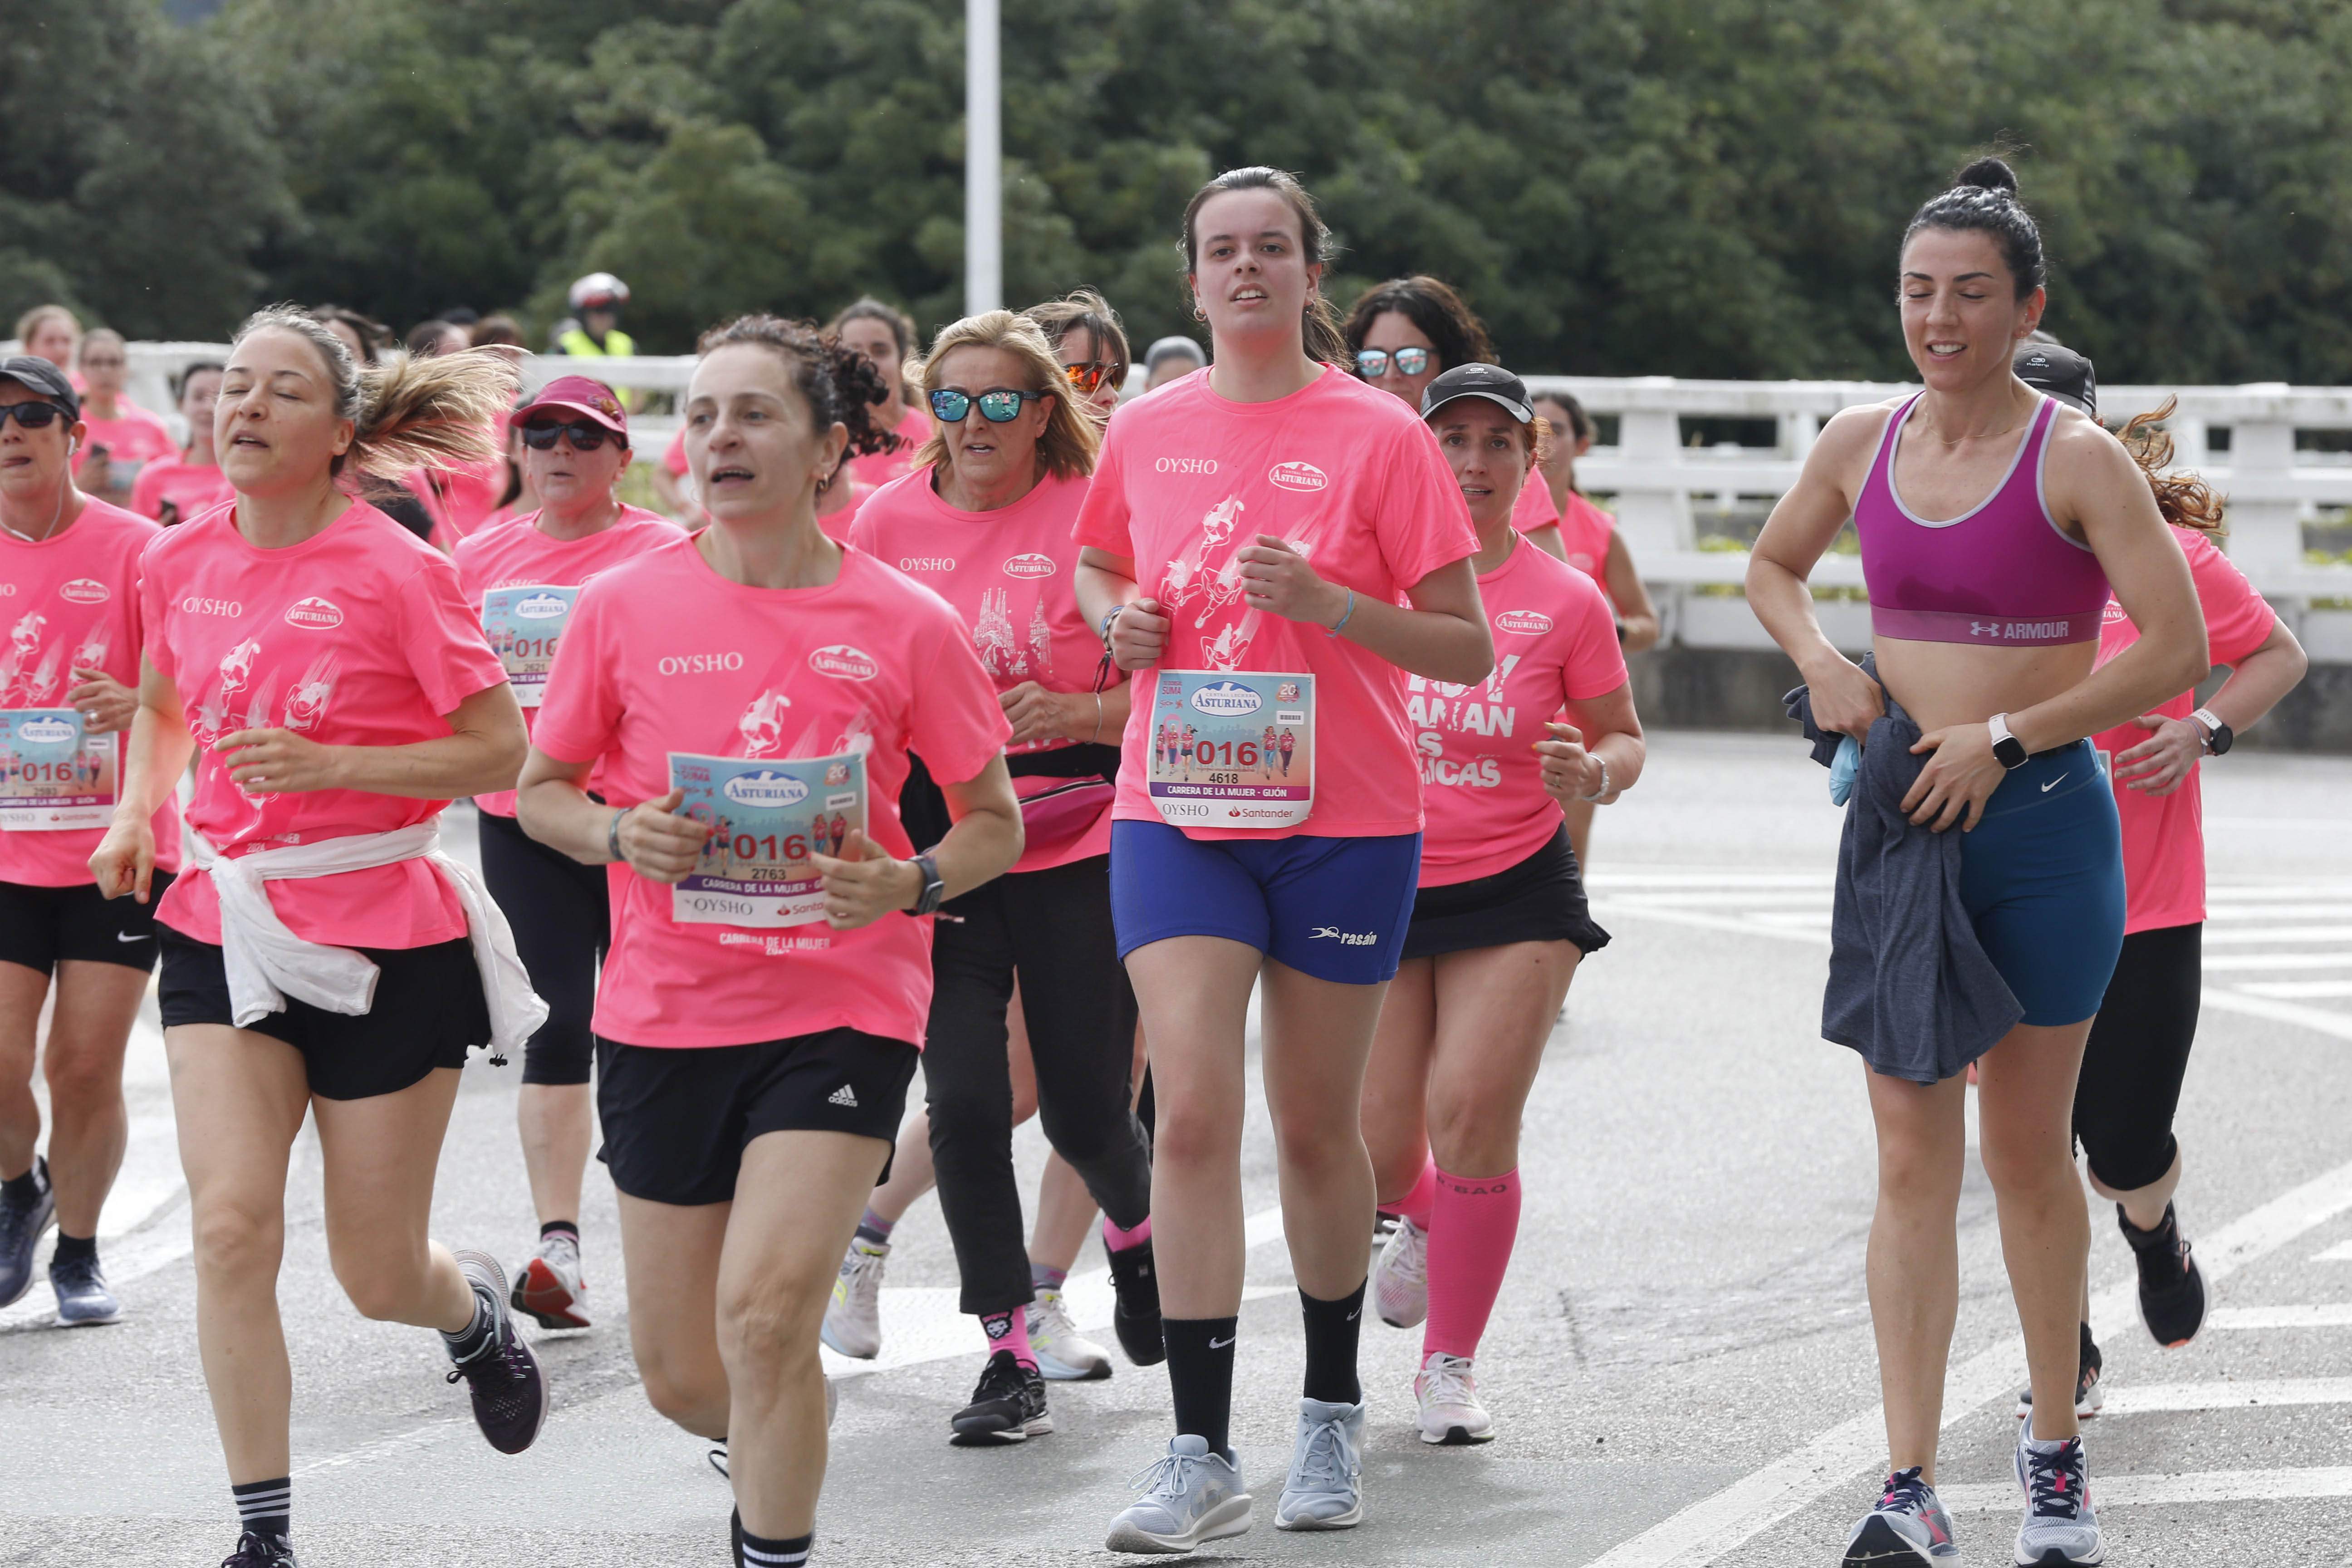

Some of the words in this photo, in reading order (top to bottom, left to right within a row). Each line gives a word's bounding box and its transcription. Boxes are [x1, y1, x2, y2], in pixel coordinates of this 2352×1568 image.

[1156, 457, 1218, 475] OYSHO
[1272, 469, 1322, 487] ASTURIANA
[900, 557, 956, 571] OYSHO
[1007, 562, 1051, 573] ASTURIANA
[182, 597, 242, 617] OYSHO
[1500, 617, 1548, 630] ASTURIANA
[2004, 621, 2068, 639] ARMOUR
[659, 652, 743, 676] OYSHO
[1195, 693, 1257, 708] ASTURIANA
[1196, 740, 1259, 766] 016
[23, 762, 73, 781] 016
[1209, 773, 1239, 784] 4618
[729, 783, 804, 799] ASTURIANA
[1167, 786, 1201, 795] CARRERA
[1203, 787, 1213, 795] DE
[1215, 788, 1225, 796] LA
[1227, 788, 1255, 796] MUJER
[1262, 787, 1287, 797] GIJÓN
[1162, 803, 1209, 816] OYSHO
[1242, 808, 1294, 818] Santander
[734, 833, 807, 860] 016
[751, 868, 786, 880] 2763
[701, 877, 741, 891] CARRERA
[745, 884, 757, 892] DE
[759, 884, 772, 893] LA
[774, 883, 806, 893] MUJER
[694, 897, 753, 916] OYSHO
[765, 937, 780, 949] DE
[782, 938, 794, 949] LA
[796, 938, 830, 950] MUJER
[1340, 931, 1377, 946] rasán
[828, 1096, 858, 1107] adidas
